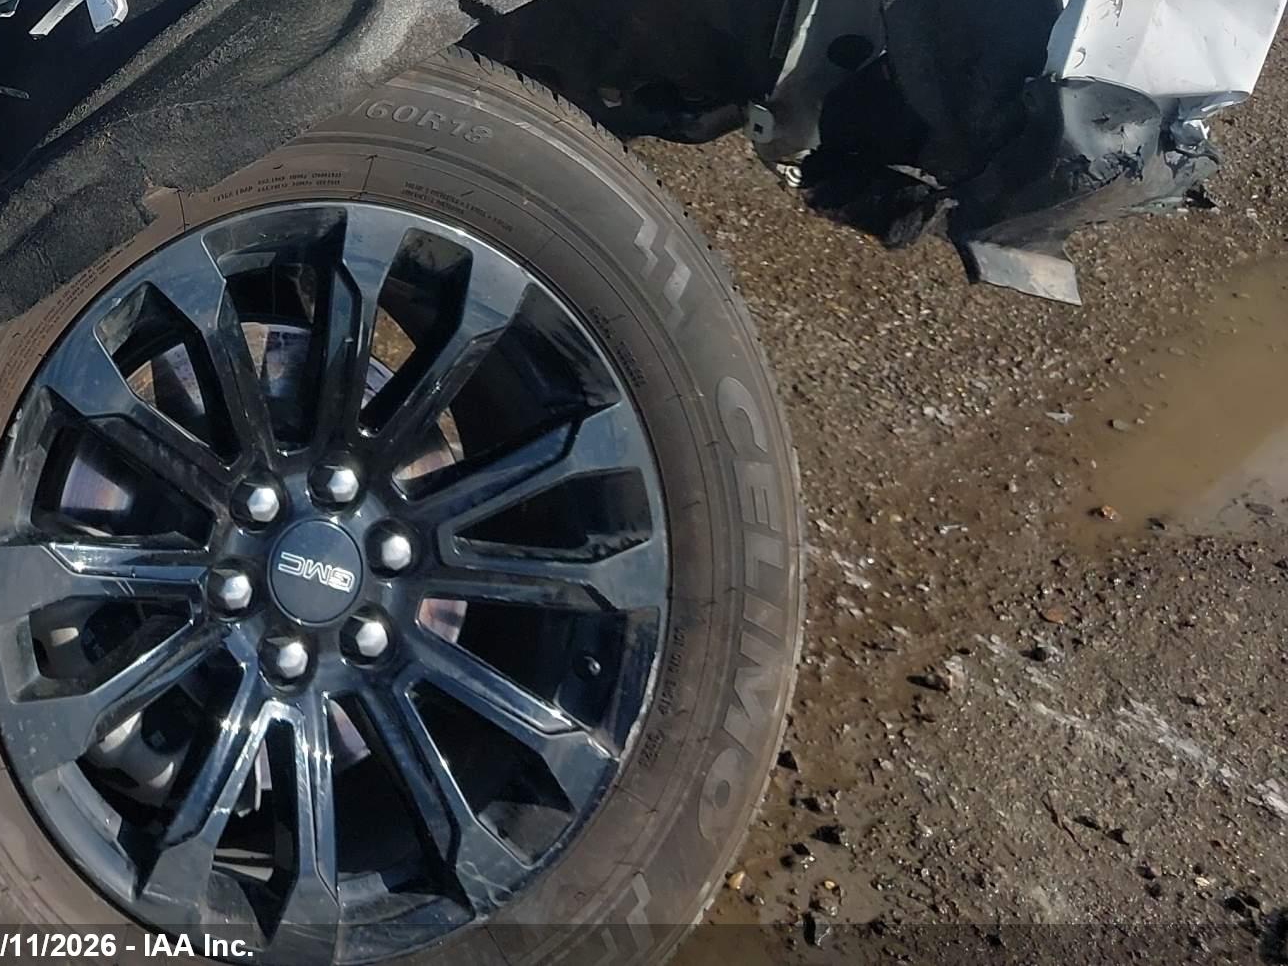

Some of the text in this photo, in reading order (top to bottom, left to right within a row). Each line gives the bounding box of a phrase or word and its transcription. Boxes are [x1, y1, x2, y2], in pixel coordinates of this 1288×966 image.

[350, 96, 494, 146] /60R18
[278, 551, 355, 593] GMC
[698, 376, 786, 842] CELIMO
